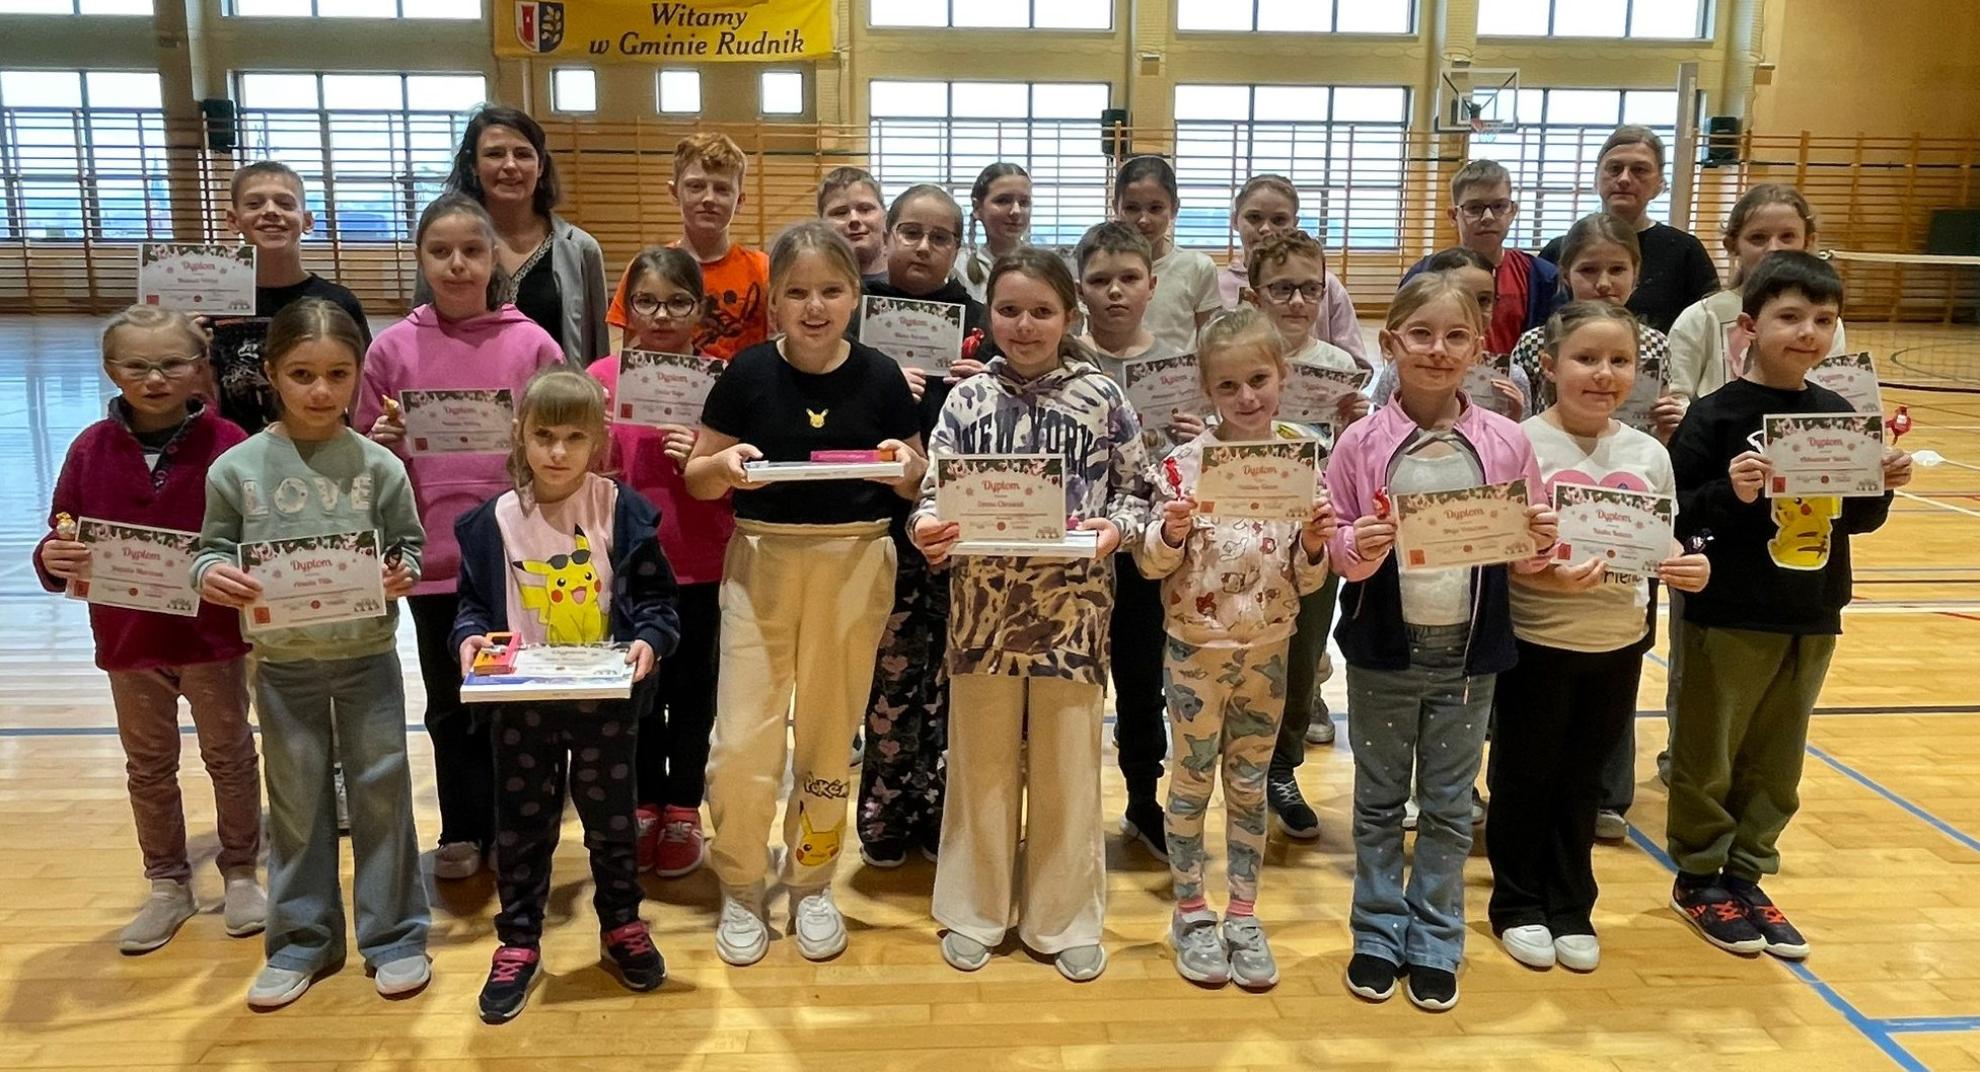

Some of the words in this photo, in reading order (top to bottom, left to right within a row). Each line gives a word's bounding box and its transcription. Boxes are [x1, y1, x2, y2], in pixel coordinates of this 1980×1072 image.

[651, 3, 747, 30] Witamy
[589, 38, 610, 54] w
[619, 32, 708, 55] Gminie
[715, 29, 805, 55] Rudnik
[1242, 464, 1278, 479] Dyplom
[981, 480, 1020, 494] Dyplom
[243, 477, 370, 517] LOVE
[1444, 508, 1486, 522] Dyplom
[1595, 509, 1632, 524] Dyplom
[121, 547, 161, 562] Dyplom
[289, 558, 333, 573] Dyplom
